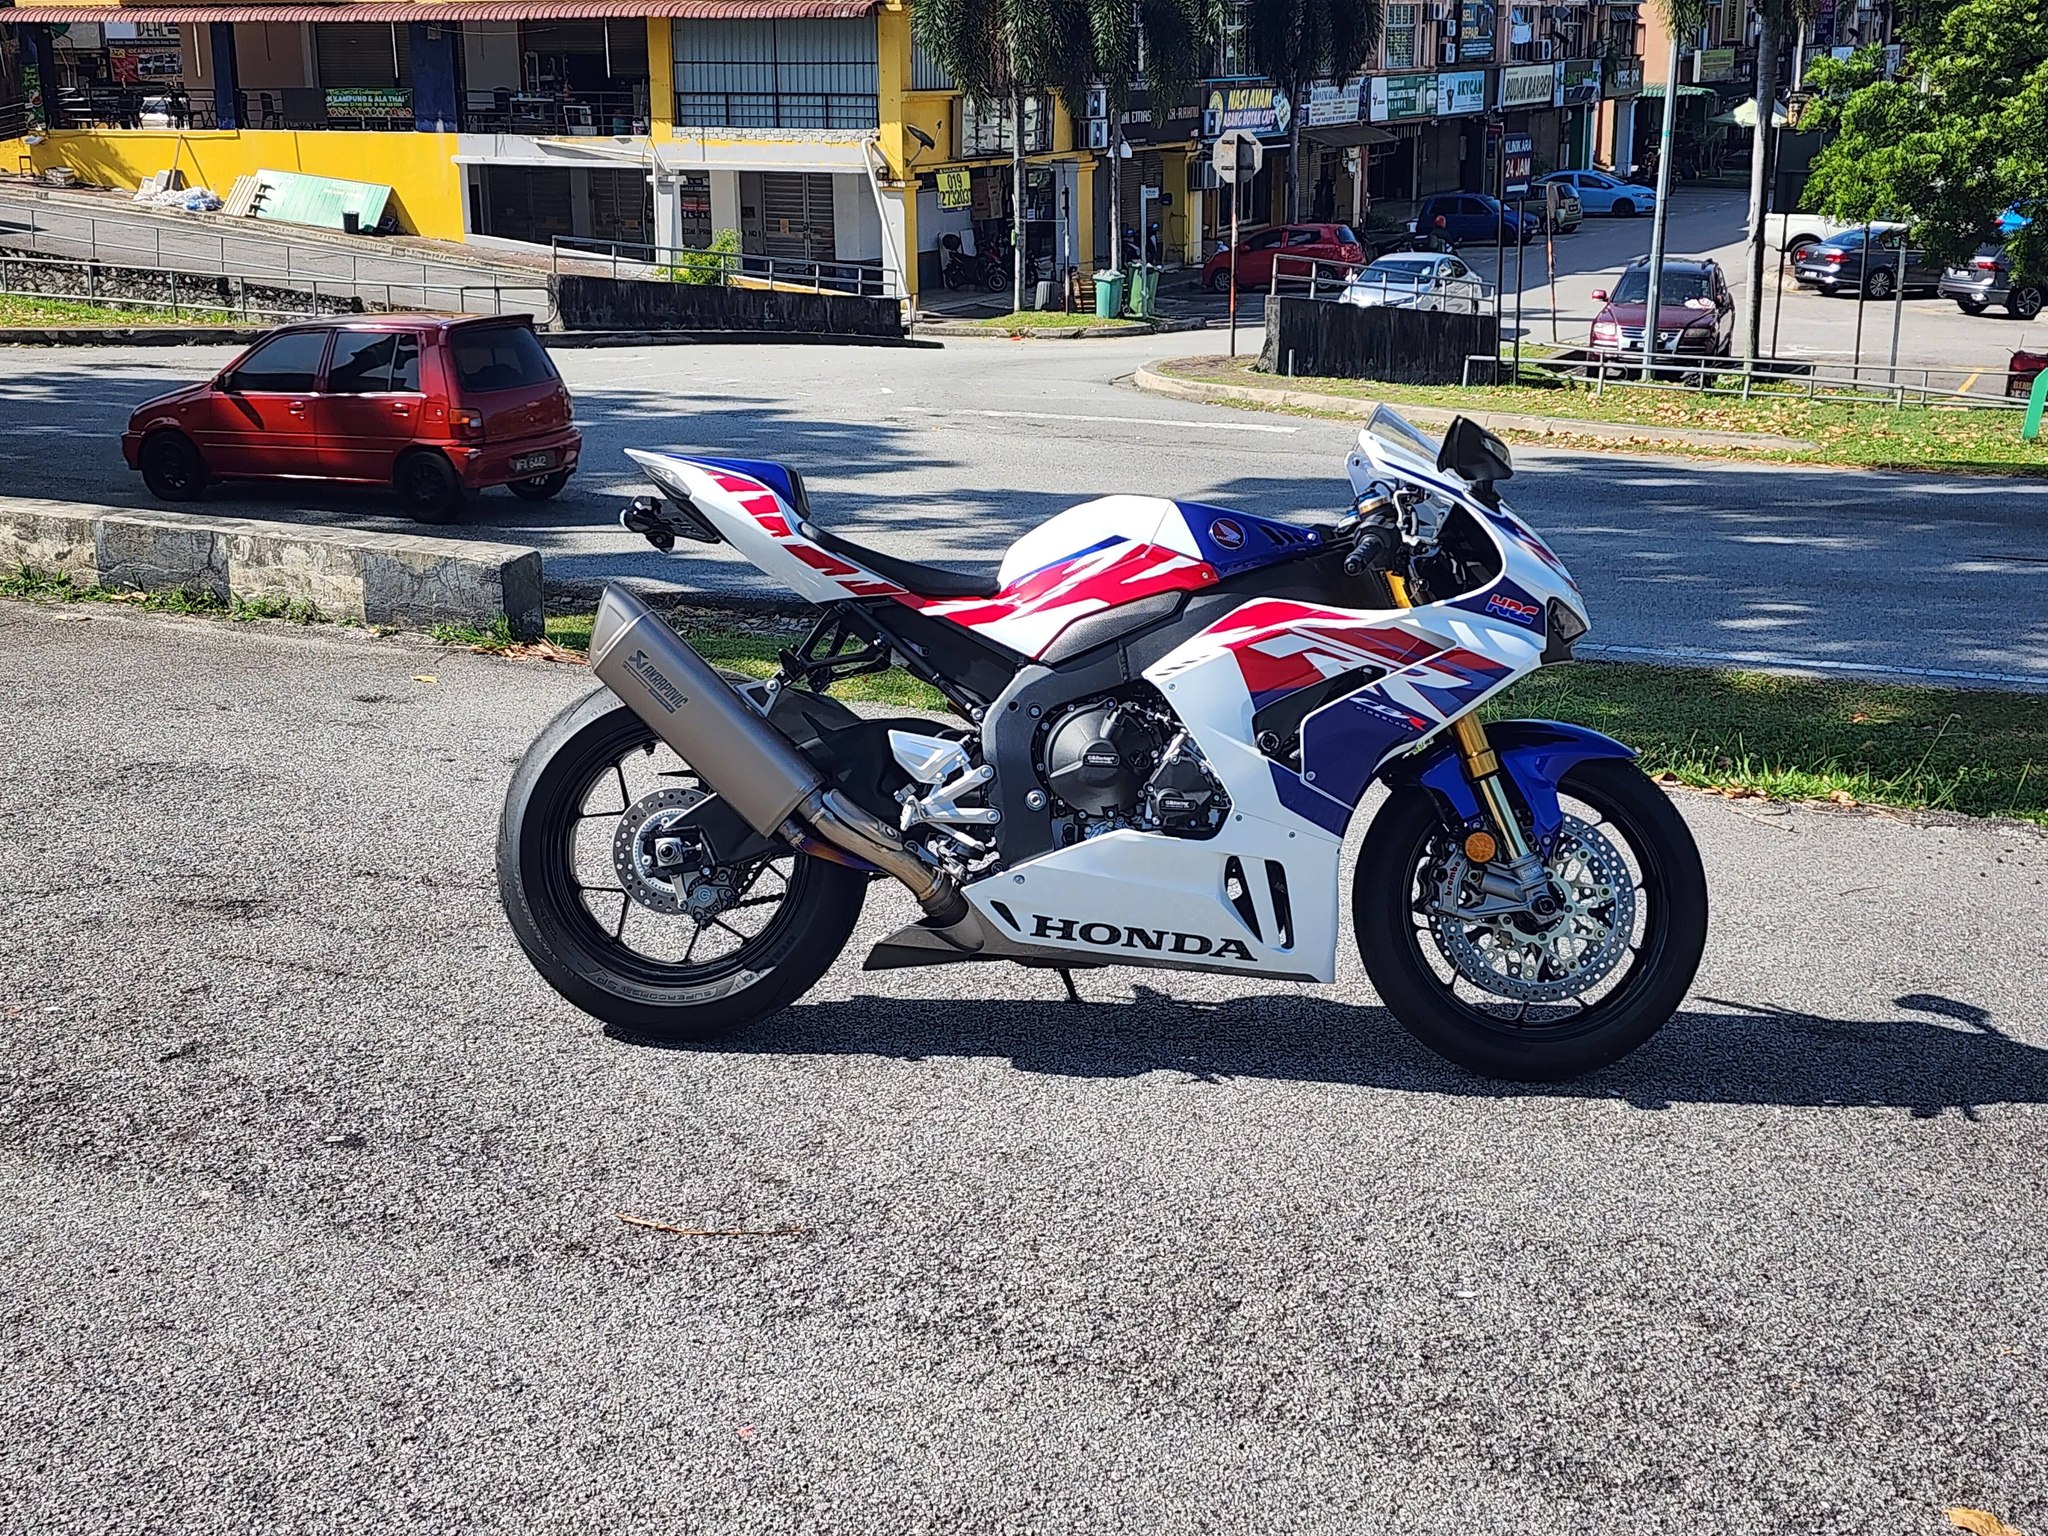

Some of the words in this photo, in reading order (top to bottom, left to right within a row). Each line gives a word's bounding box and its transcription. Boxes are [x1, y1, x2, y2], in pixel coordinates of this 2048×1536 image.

[1227, 88, 1250, 111] NASI
[1248, 88, 1273, 109] AYAM
[1131, 109, 1152, 124] EMAS
[1223, 111, 1243, 127] ABANG
[1505, 159, 1514, 178] 24
[1515, 157, 1531, 177] JAM
[946, 173, 963, 189] 019
[1485, 594, 1540, 625] HRC
[1355, 705, 1414, 731] FIREBLADE
[1444, 860, 1461, 897] brembo
[1029, 914, 1259, 962] HONDA
